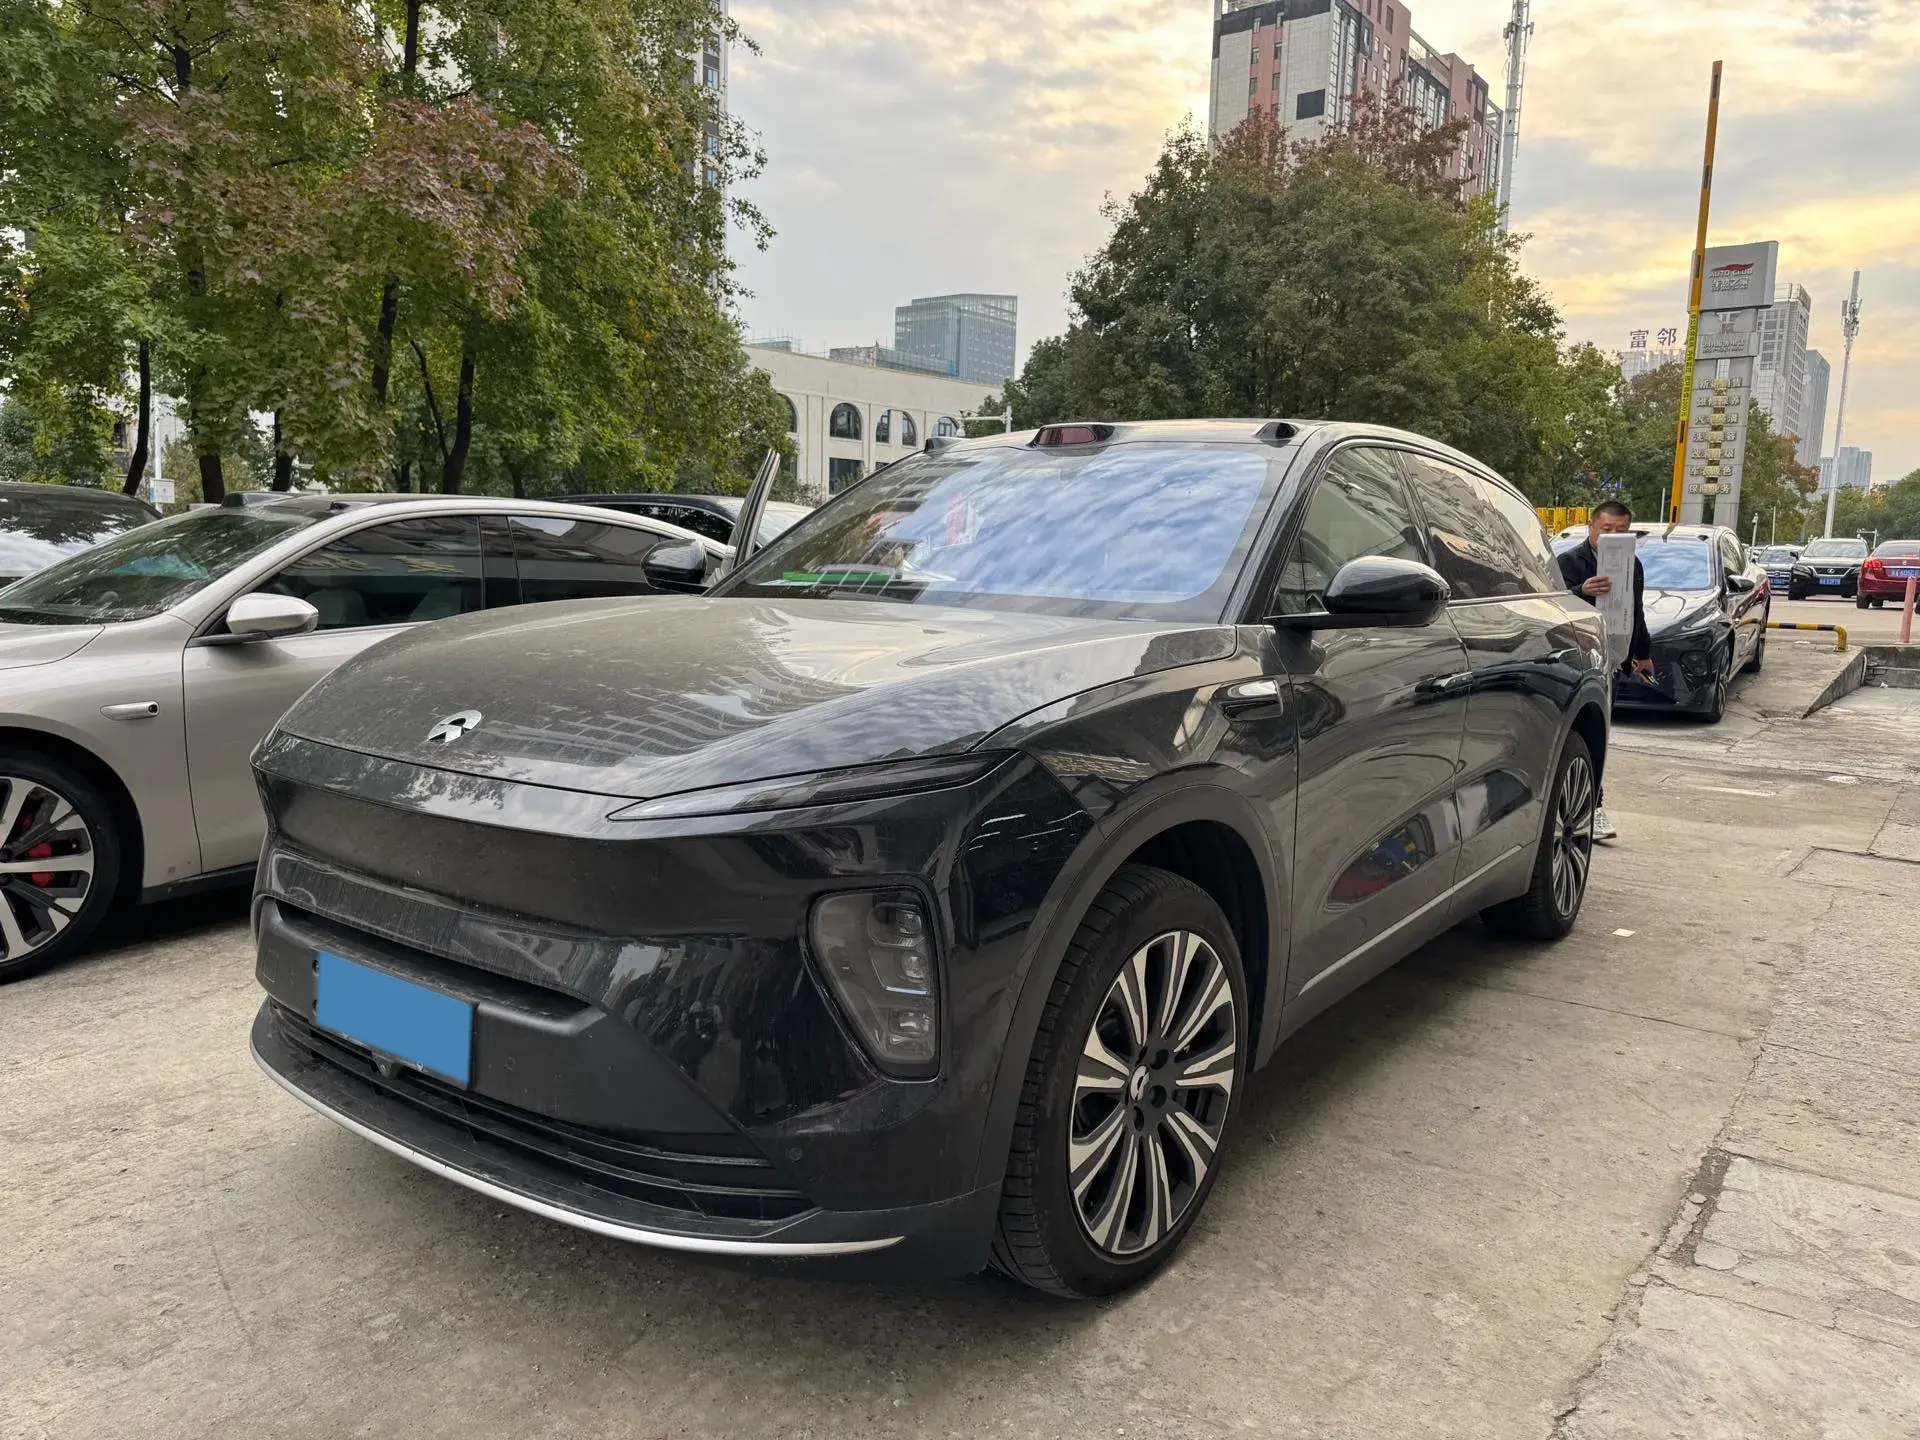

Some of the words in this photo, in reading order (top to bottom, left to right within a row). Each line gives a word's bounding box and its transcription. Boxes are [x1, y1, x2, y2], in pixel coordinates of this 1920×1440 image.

[1709, 270, 1730, 279] AUTO
[1732, 268, 1753, 276] CLUB
[1630, 327, 1688, 349] 富邻
